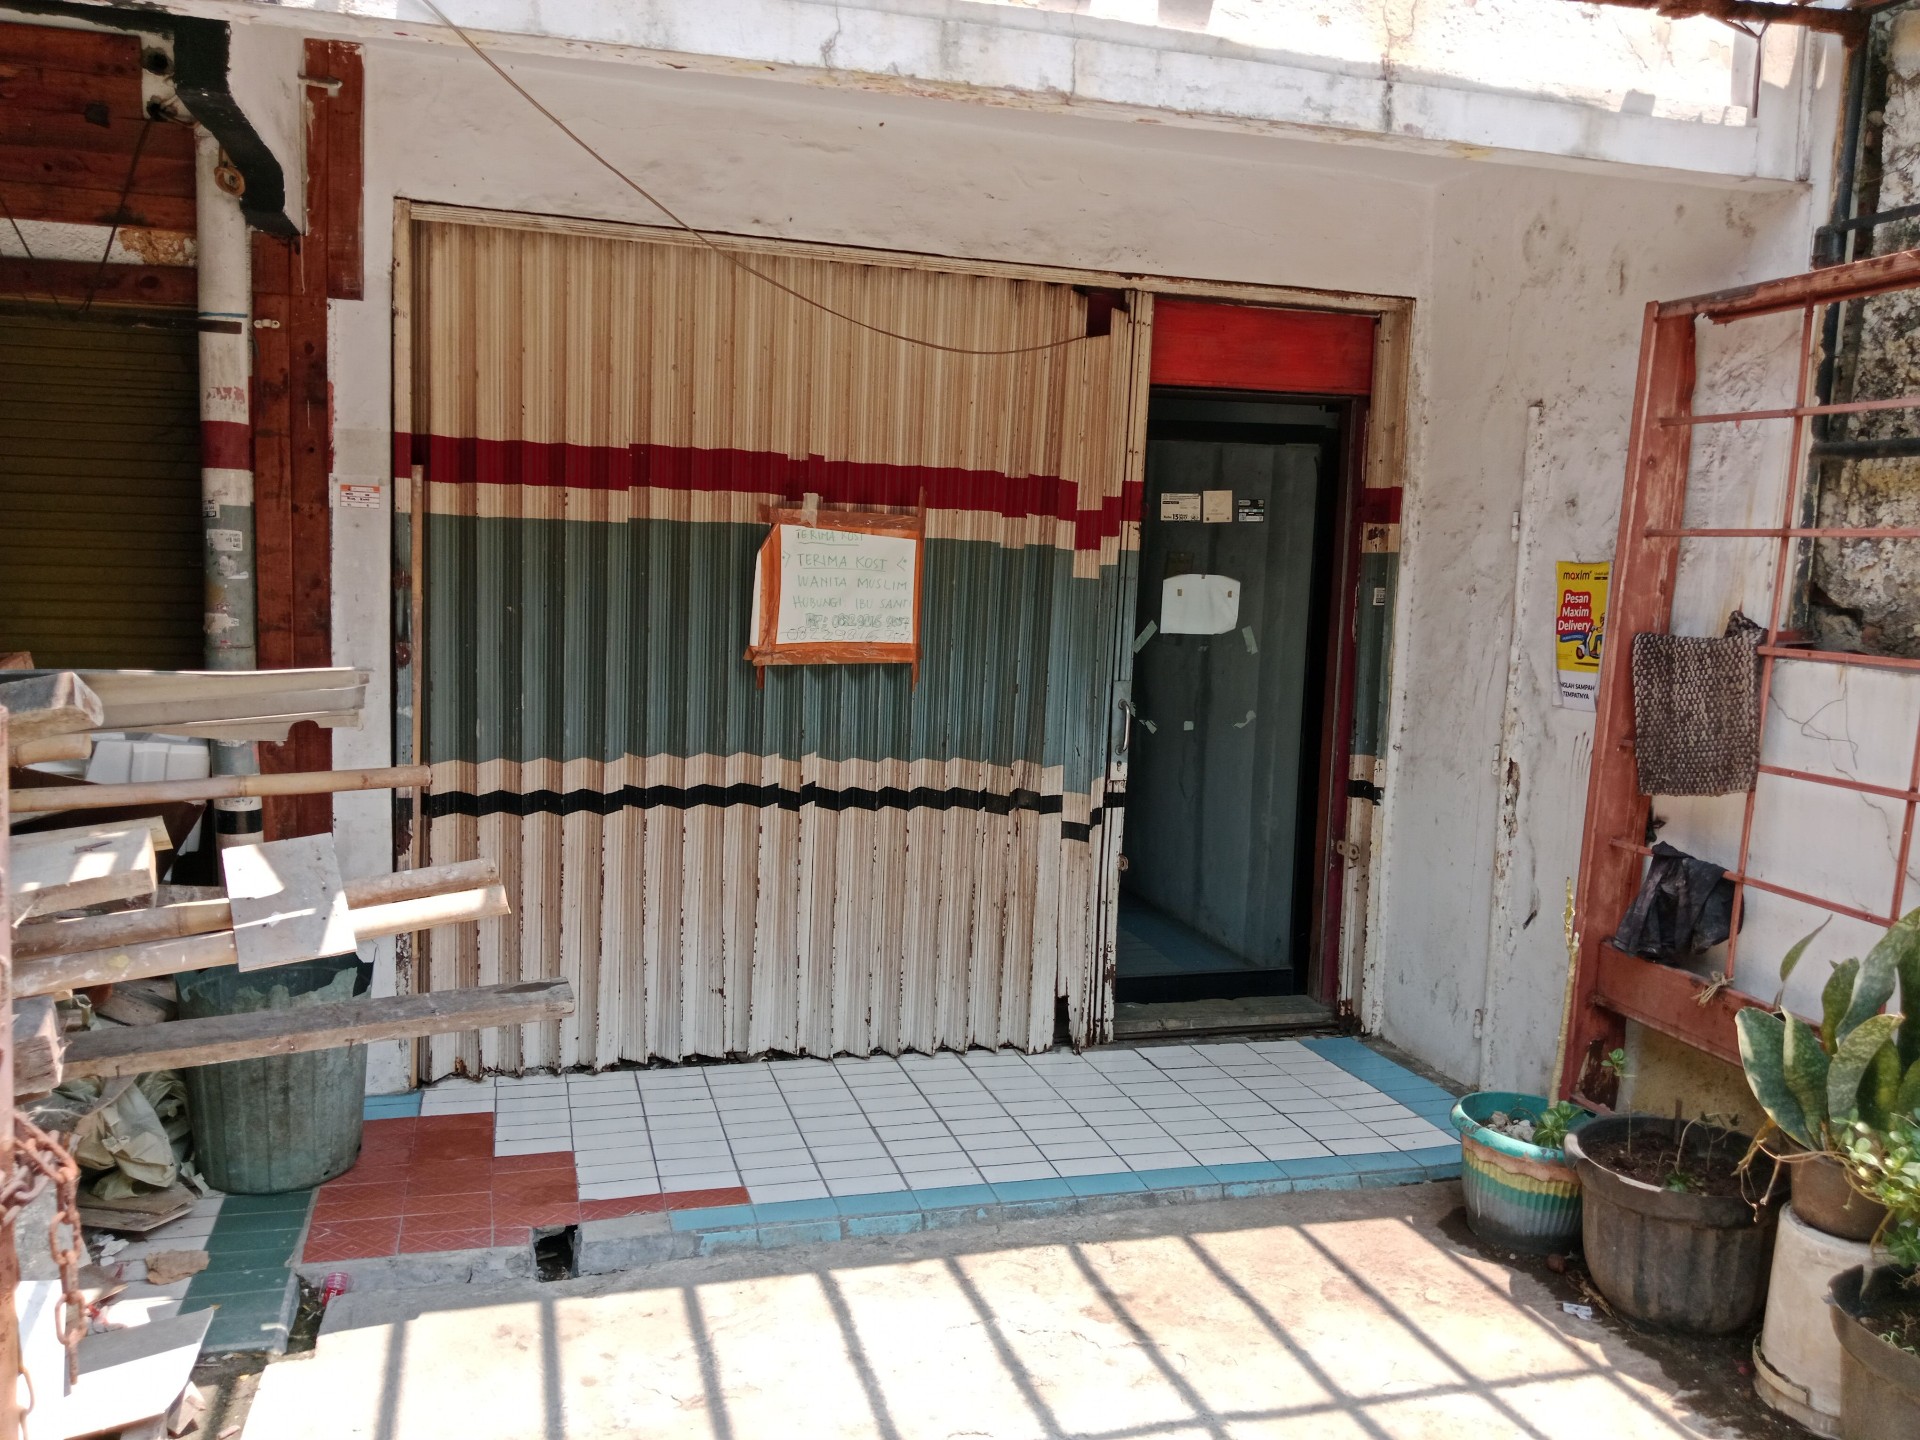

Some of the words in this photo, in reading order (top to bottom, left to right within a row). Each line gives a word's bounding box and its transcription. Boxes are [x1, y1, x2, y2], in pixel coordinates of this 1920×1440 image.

[796, 529, 835, 542] TERIMA
[797, 553, 847, 567] TERIMA
[855, 555, 888, 570] KOST
[1562, 569, 1590, 581] maxim
[798, 575, 847, 588] WANITA
[857, 577, 908, 591] MUSLIM
[793, 595, 842, 609] HUBUNGI
[855, 599, 873, 610] IBU
[1565, 593, 1589, 604] Pesan
[1562, 605, 1590, 617] Maxim
[1558, 619, 1591, 633] Delivery
